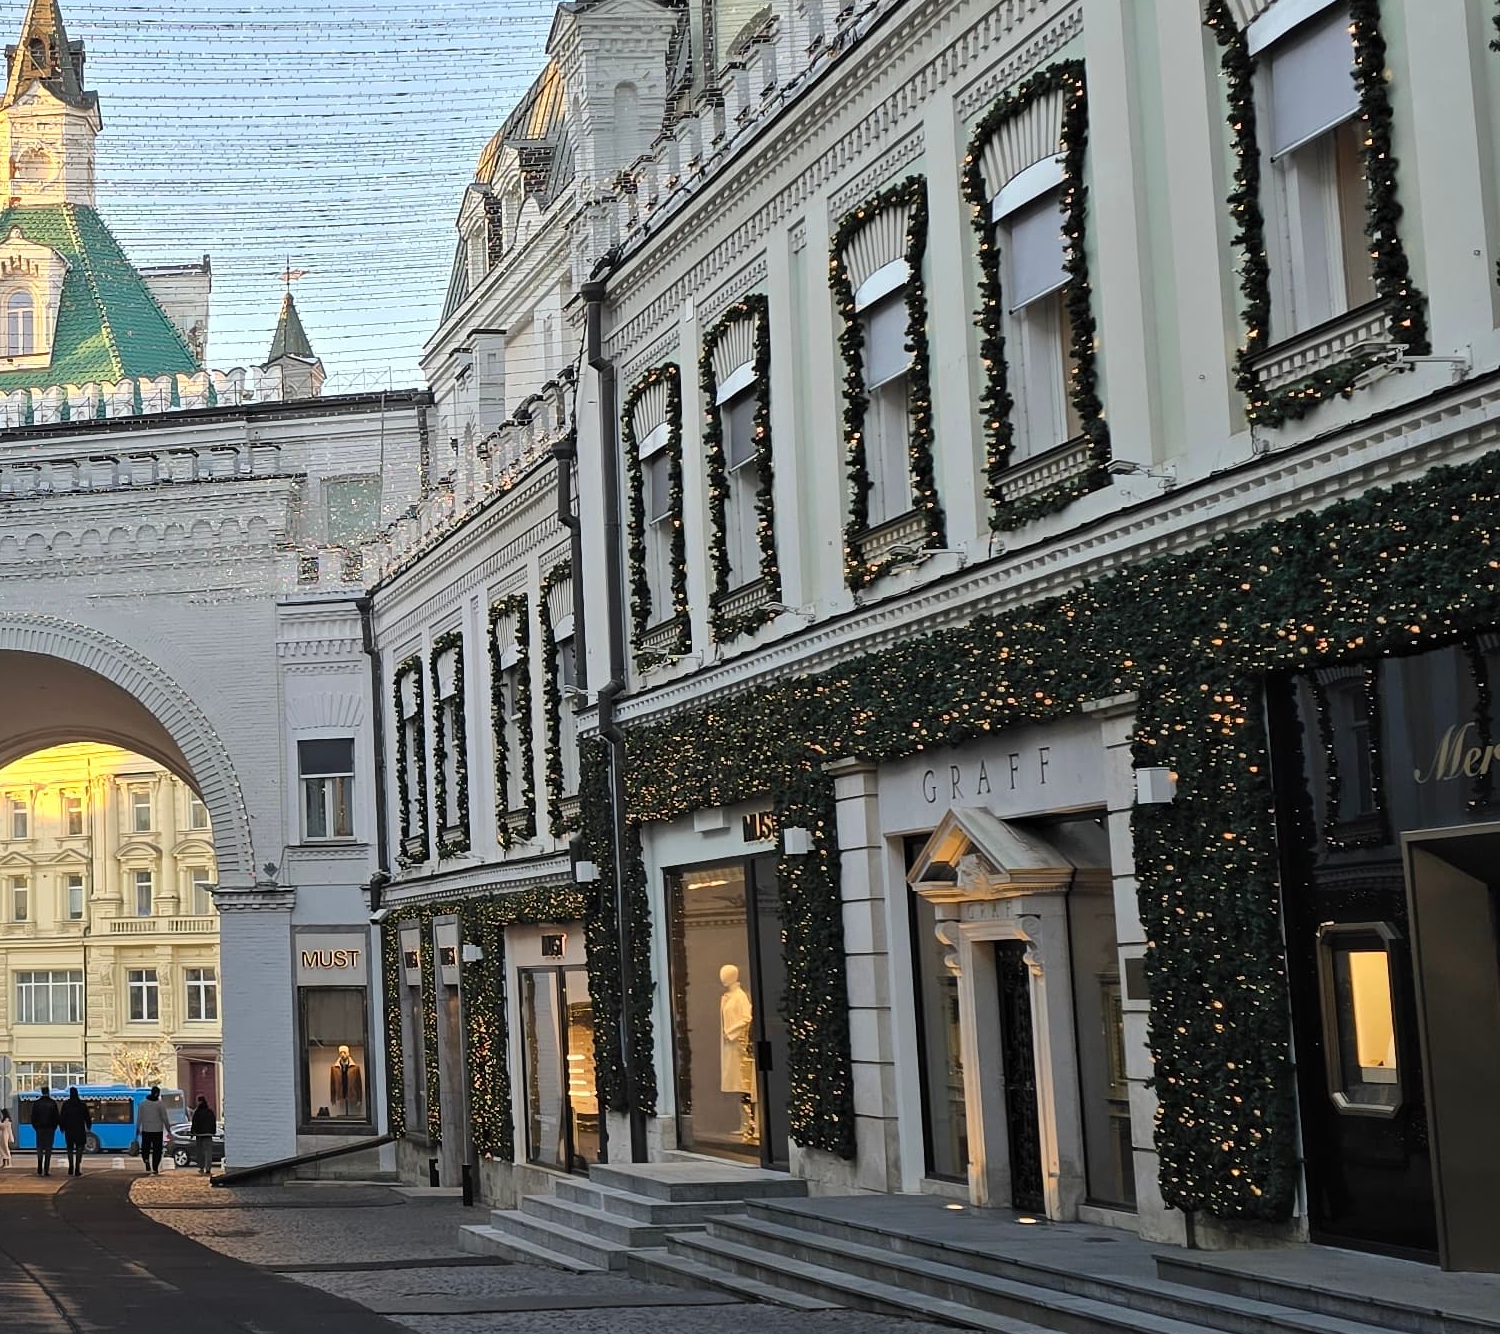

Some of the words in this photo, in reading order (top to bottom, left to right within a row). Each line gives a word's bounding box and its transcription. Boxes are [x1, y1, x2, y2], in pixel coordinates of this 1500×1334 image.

[922, 746, 1050, 804] GRAFF
[742, 811, 778, 843] MUS
[301, 950, 360, 968] MUST
